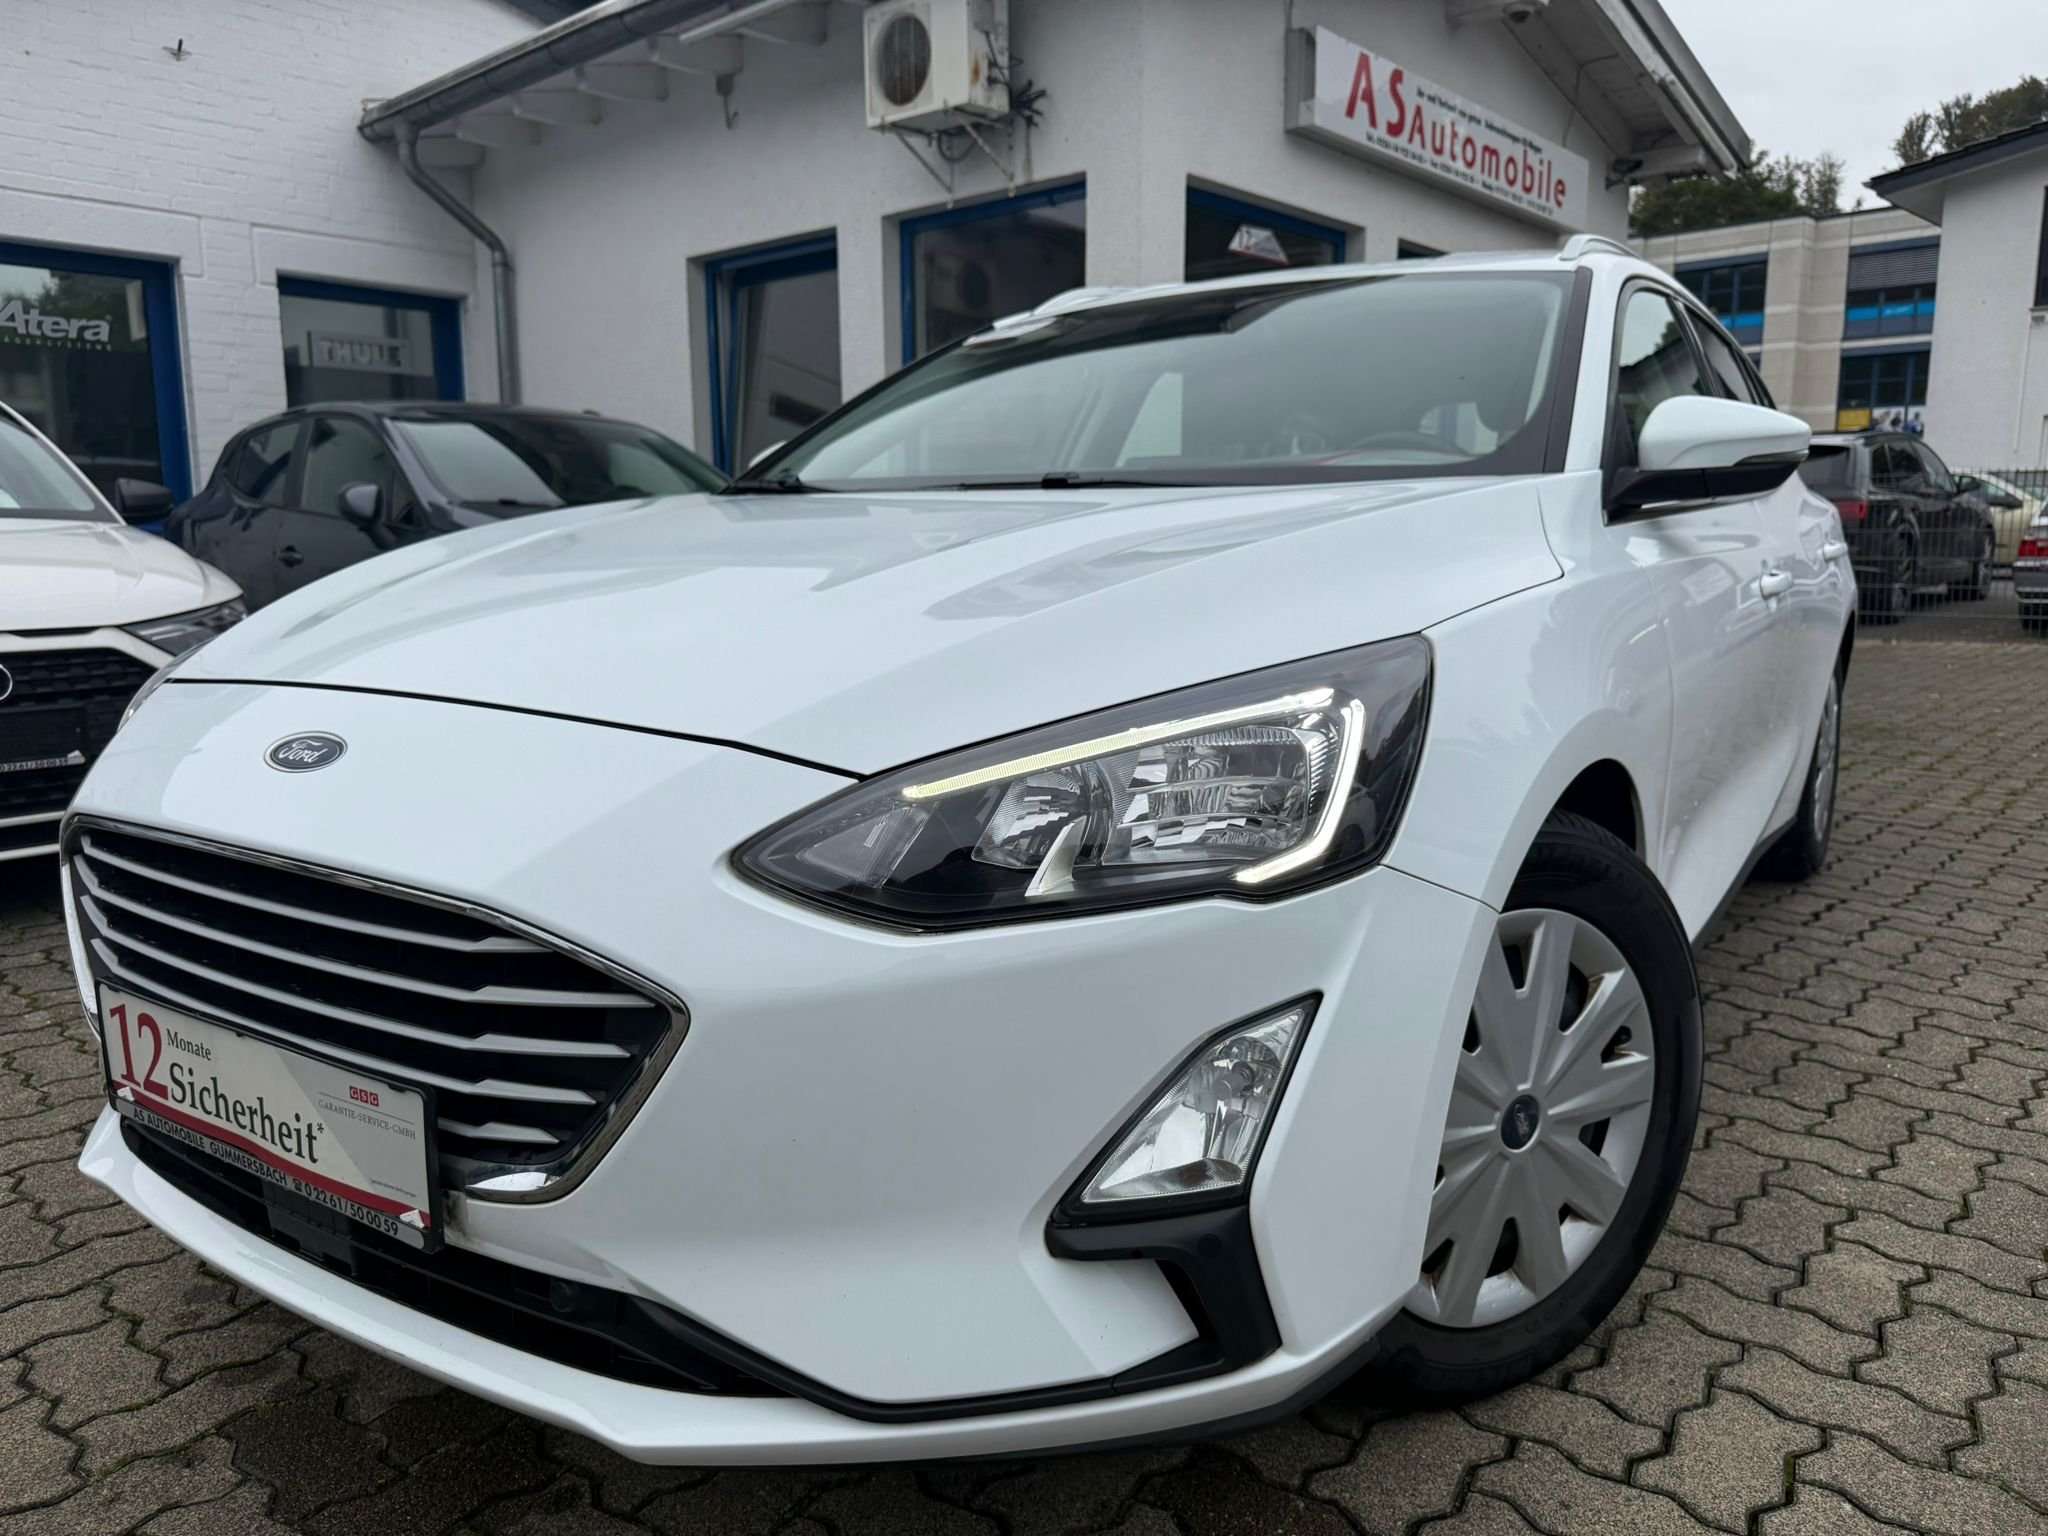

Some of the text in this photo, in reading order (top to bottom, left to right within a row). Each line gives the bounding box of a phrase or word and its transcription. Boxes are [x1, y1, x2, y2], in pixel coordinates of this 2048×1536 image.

[1408, 104, 1566, 208] Automobile
[0, 300, 110, 342] Atera
[278, 739, 329, 763] Ford
[110, 1003, 169, 1100] 12
[166, 1028, 212, 1061] Monate
[133, 1107, 145, 1122] AS
[147, 1113, 206, 1149] AUTOMOBILE
[210, 1141, 288, 1186] GUMMERSBACH
